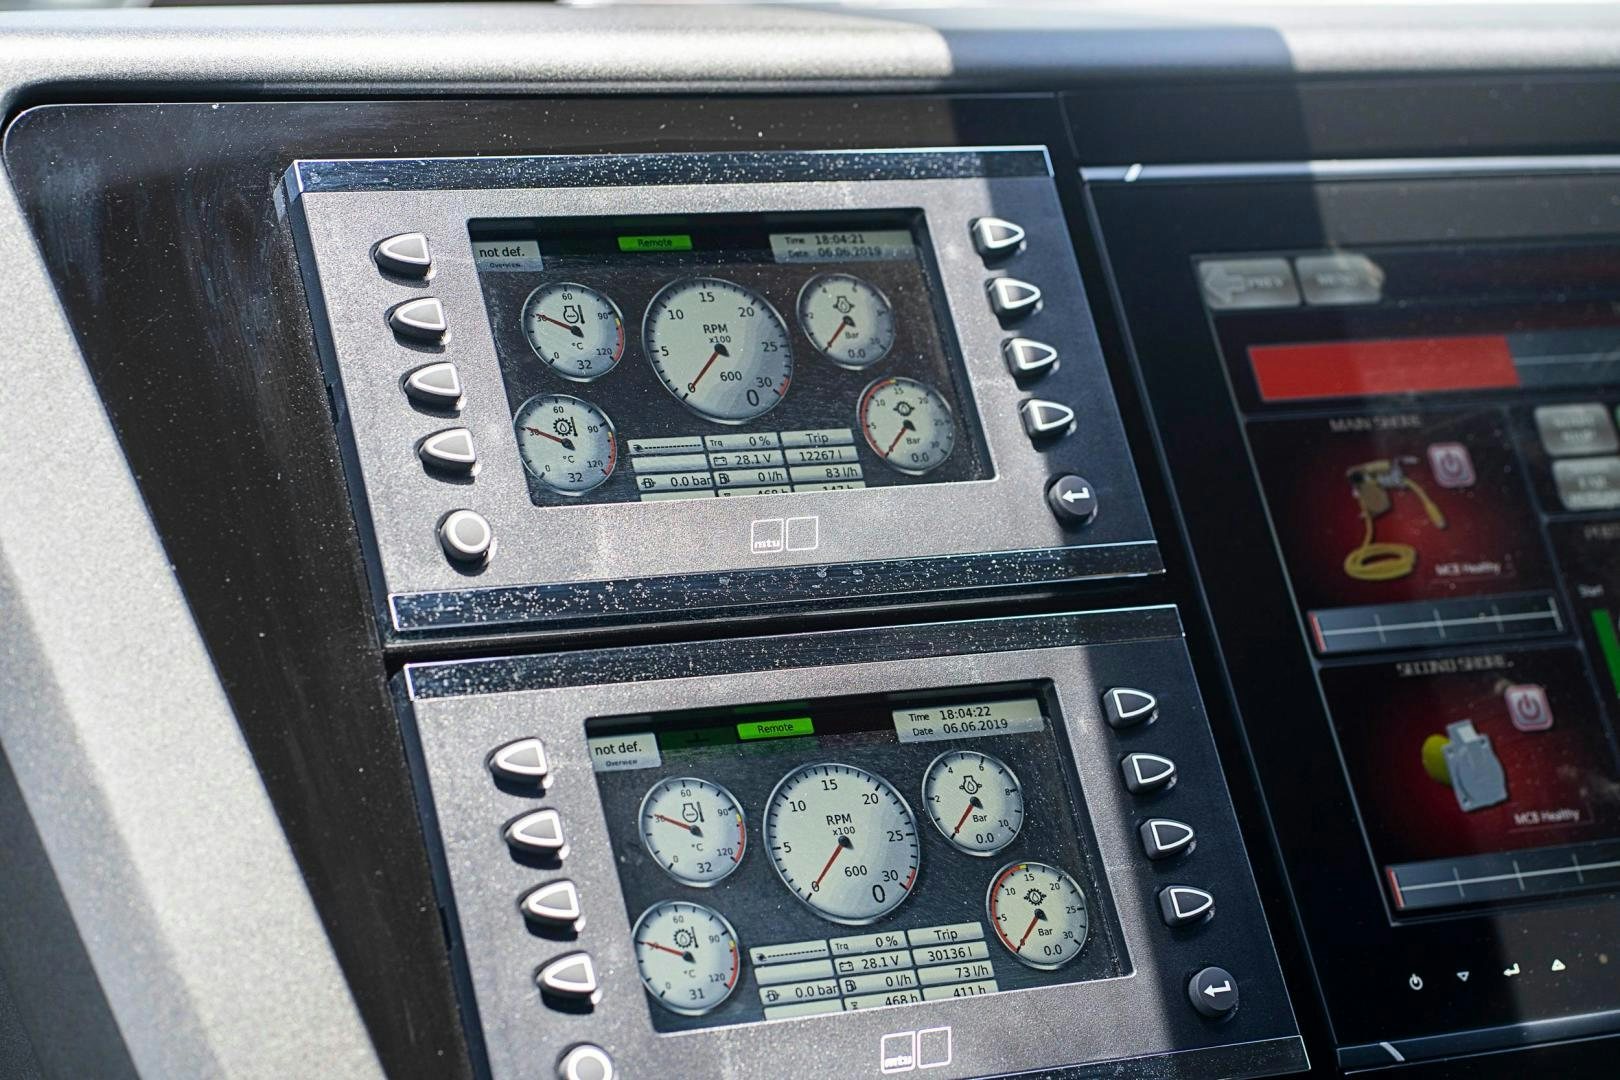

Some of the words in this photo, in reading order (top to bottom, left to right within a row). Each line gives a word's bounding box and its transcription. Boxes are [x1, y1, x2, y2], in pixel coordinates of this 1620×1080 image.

[637, 238, 673, 247] Remote
[785, 236, 805, 245] Time
[815, 234, 865, 245] 18:04:21
[479, 249, 500, 258] not
[502, 246, 525, 257] def.
[562, 293, 573, 301] 60
[699, 292, 715, 302] 15
[668, 310, 684, 320] 10
[739, 307, 754, 318] 20
[703, 324, 728, 334] RPM
[709, 336, 731, 344] x100
[661, 346, 669, 357] 5
[762, 342, 778, 352] 25
[848, 349, 865, 358] 0.0
[577, 360, 593, 370] 32
[720, 371, 742, 381] 600
[756, 377, 772, 388] 30
[747, 389, 759, 406] 0
[749, 437, 756, 446] 0
[759, 436, 770, 445] %
[806, 433, 829, 444] Trip
[907, 437, 920, 445] Bar
[735, 454, 760, 465] 28.1
[763, 454, 772, 463] V
[800, 451, 837, 461] 12267
[911, 453, 929, 463] 0.0
[587, 460, 603, 468] 120
[568, 473, 583, 482] 32
[758, 473, 766, 482] 0
[826, 468, 841, 478] 83
[671, 477, 689, 487] 0.0
[693, 475, 712, 485] bar
[909, 713, 930, 721] Time
[939, 706, 991, 720] 18:04:22
[757, 723, 793, 733] Remote
[913, 727, 933, 736] Date
[943, 719, 1008, 734] 06.06.2019
[595, 744, 616, 755] not
[618, 742, 642, 753] def.
[979, 764, 984, 772] 6
[822, 779, 838, 791] 15
[681, 789, 691, 797] 60
[1005, 788, 1011, 796] 8
[862, 794, 879, 805] 20
[935, 795, 941, 803] 2
[790, 801, 806, 813] 10
[826, 814, 853, 826] RPM
[972, 814, 987, 823] Bar
[999, 820, 1009, 828] 10
[833, 827, 856, 835] x100
[887, 831, 904, 842] 25
[976, 833, 994, 844] 0.0
[717, 848, 733, 856] 120
[784, 842, 792, 853] 5
[673, 855, 679, 863] 0
[697, 862, 712, 873] 32
[844, 866, 868, 877] 600
[882, 870, 899, 882] 30
[1024, 873, 1035, 882] 15
[1005, 887, 1016, 896] 10
[1049, 882, 1060, 891] 20
[872, 885, 886, 903] 0
[1066, 906, 1077, 915] 25
[673, 915, 684, 924] 60
[1002, 914, 1007, 922] 5
[934, 929, 958, 942] Trip
[1038, 928, 1053, 936] Bar
[1063, 931, 1074, 940] 30
[709, 935, 720, 943] 90
[876, 937, 883, 948] 0
[886, 935, 898, 946] %
[927, 948, 966, 962] 30136
[1044, 945, 1063, 956] 0.0
[863, 957, 888, 969] 28.1
[890, 955, 900, 966] V
[955, 967, 971, 979] 73
[973, 965, 989, 977] l/h
[709, 974, 725, 983] 120
[886, 976, 894, 987] 0
[896, 974, 911, 986] l/h
[665, 982, 671, 990] 0
[795, 987, 814, 998] 0.0
[818, 983, 838, 996] bar
[689, 989, 704, 1000] 31
[954, 986, 974, 998] 411
[978, 986, 986, 995] h
[886, 995, 906, 1006] 468
[910, 991, 918, 1002] h
